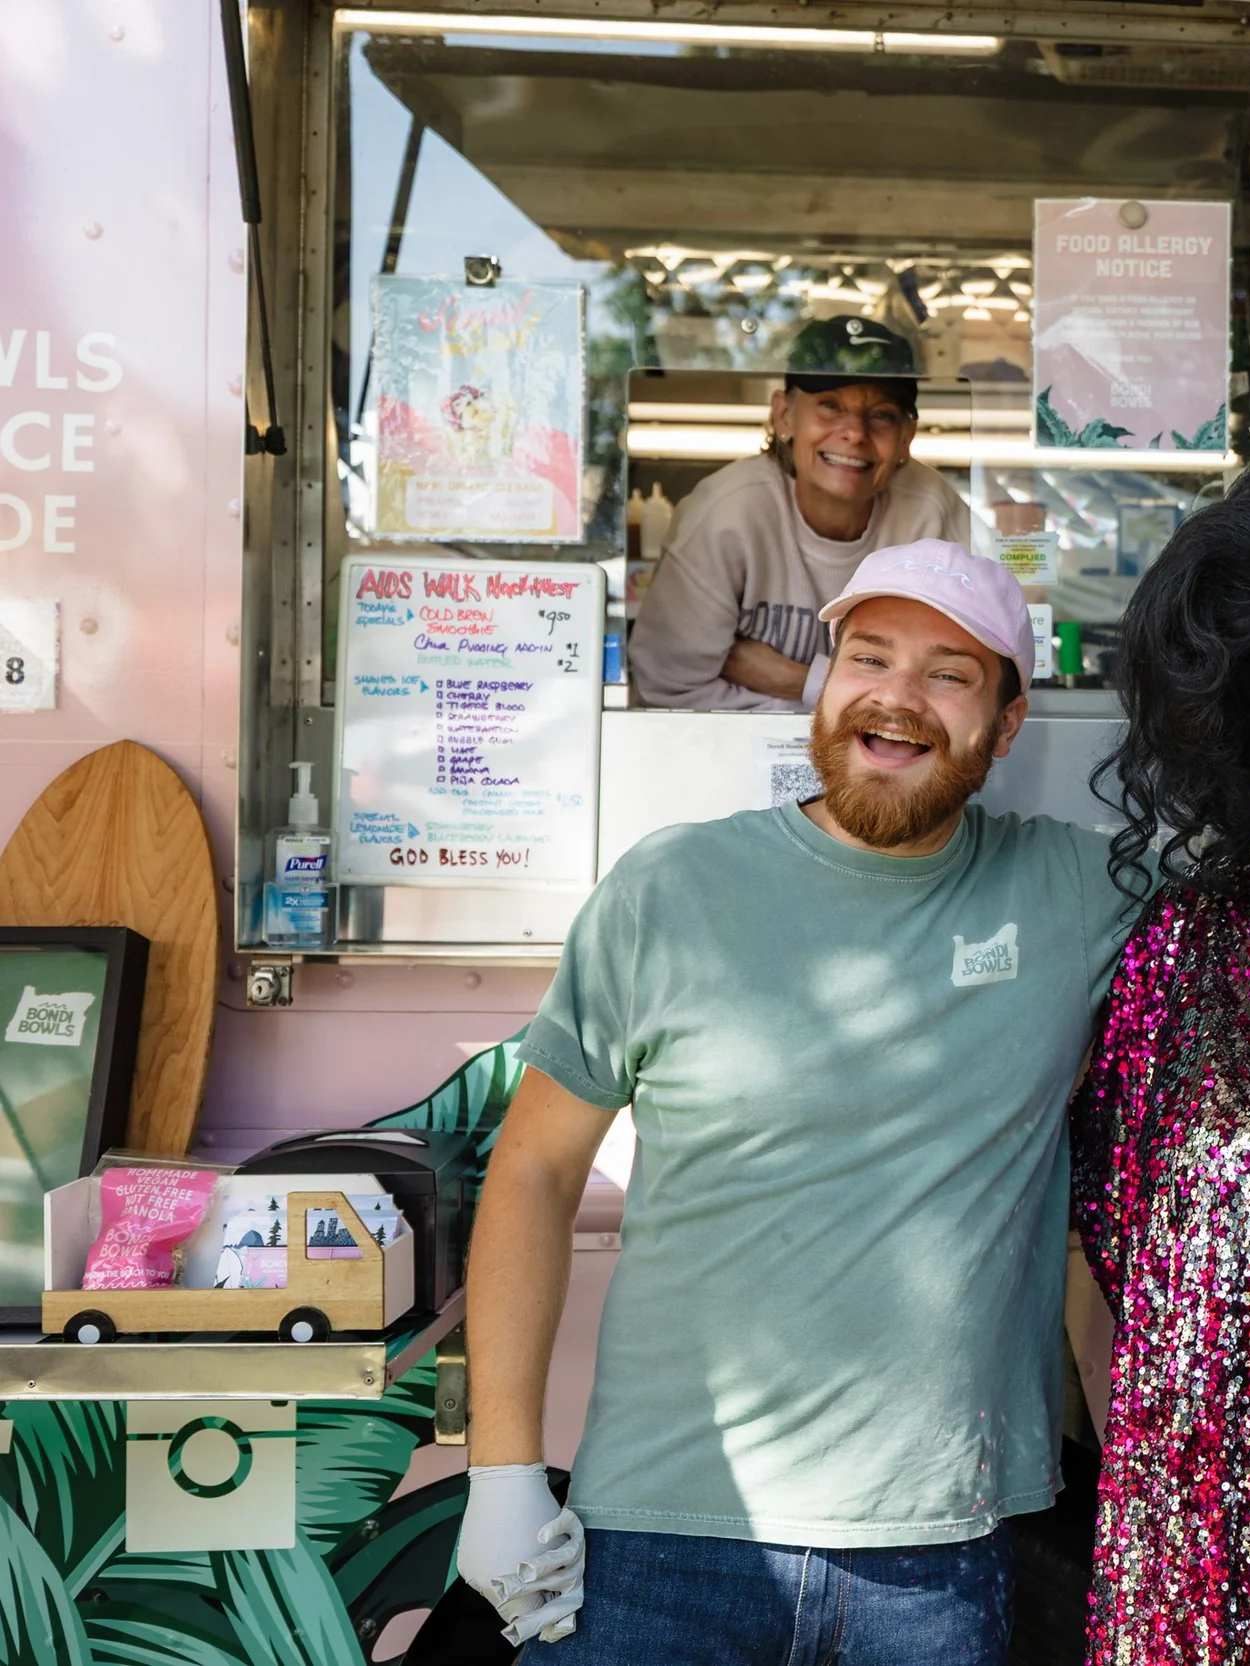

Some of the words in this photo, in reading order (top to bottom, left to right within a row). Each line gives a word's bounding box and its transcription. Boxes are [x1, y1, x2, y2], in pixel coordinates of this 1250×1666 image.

[1056, 235, 1111, 253] FOOD
[1118, 234, 1212, 255] ALLERGY
[1096, 258, 1173, 277] NOTICE
[999, 553, 1047, 561] COMPLIED
[356, 569, 412, 600] AIDS
[423, 571, 482, 602] WALK
[419, 606, 454, 623] COLD
[457, 608, 495, 623] BREW
[427, 623, 499, 636] SMOOTHIE
[5, 656, 25, 685] 8
[557, 659, 579, 673] $2
[401, 675, 421, 685] ICE
[446, 680, 472, 690] BLUE
[477, 681, 533, 693] RASPBERRY
[446, 691, 490, 700] CHERRY
[495, 702, 526, 711] BLOOD
[389, 847, 429, 867] GOD
[438, 848, 488, 867] BLESS
[496, 848, 531, 868] YOU!
[963, 943, 1009, 968] BONDI
[961, 957, 1014, 976] BOWLS
[26, 1007, 74, 1023] BONDI
[17, 1020, 75, 1037] BOWLS
[127, 1168, 198, 1180] HOMEMADE
[137, 1177, 178, 1185] VEGAN
[115, 1185, 160, 1197] GLUTEN
[162, 1187, 193, 1201] FREE
[125, 1194, 145, 1207] NUT
[149, 1196, 178, 1210] FREE
[105, 1229, 156, 1245] BONDI
[100, 1243, 150, 1258] BOWLS
[146, 1268, 155, 1277] TO
[157, 1271, 170, 1279] YOU
